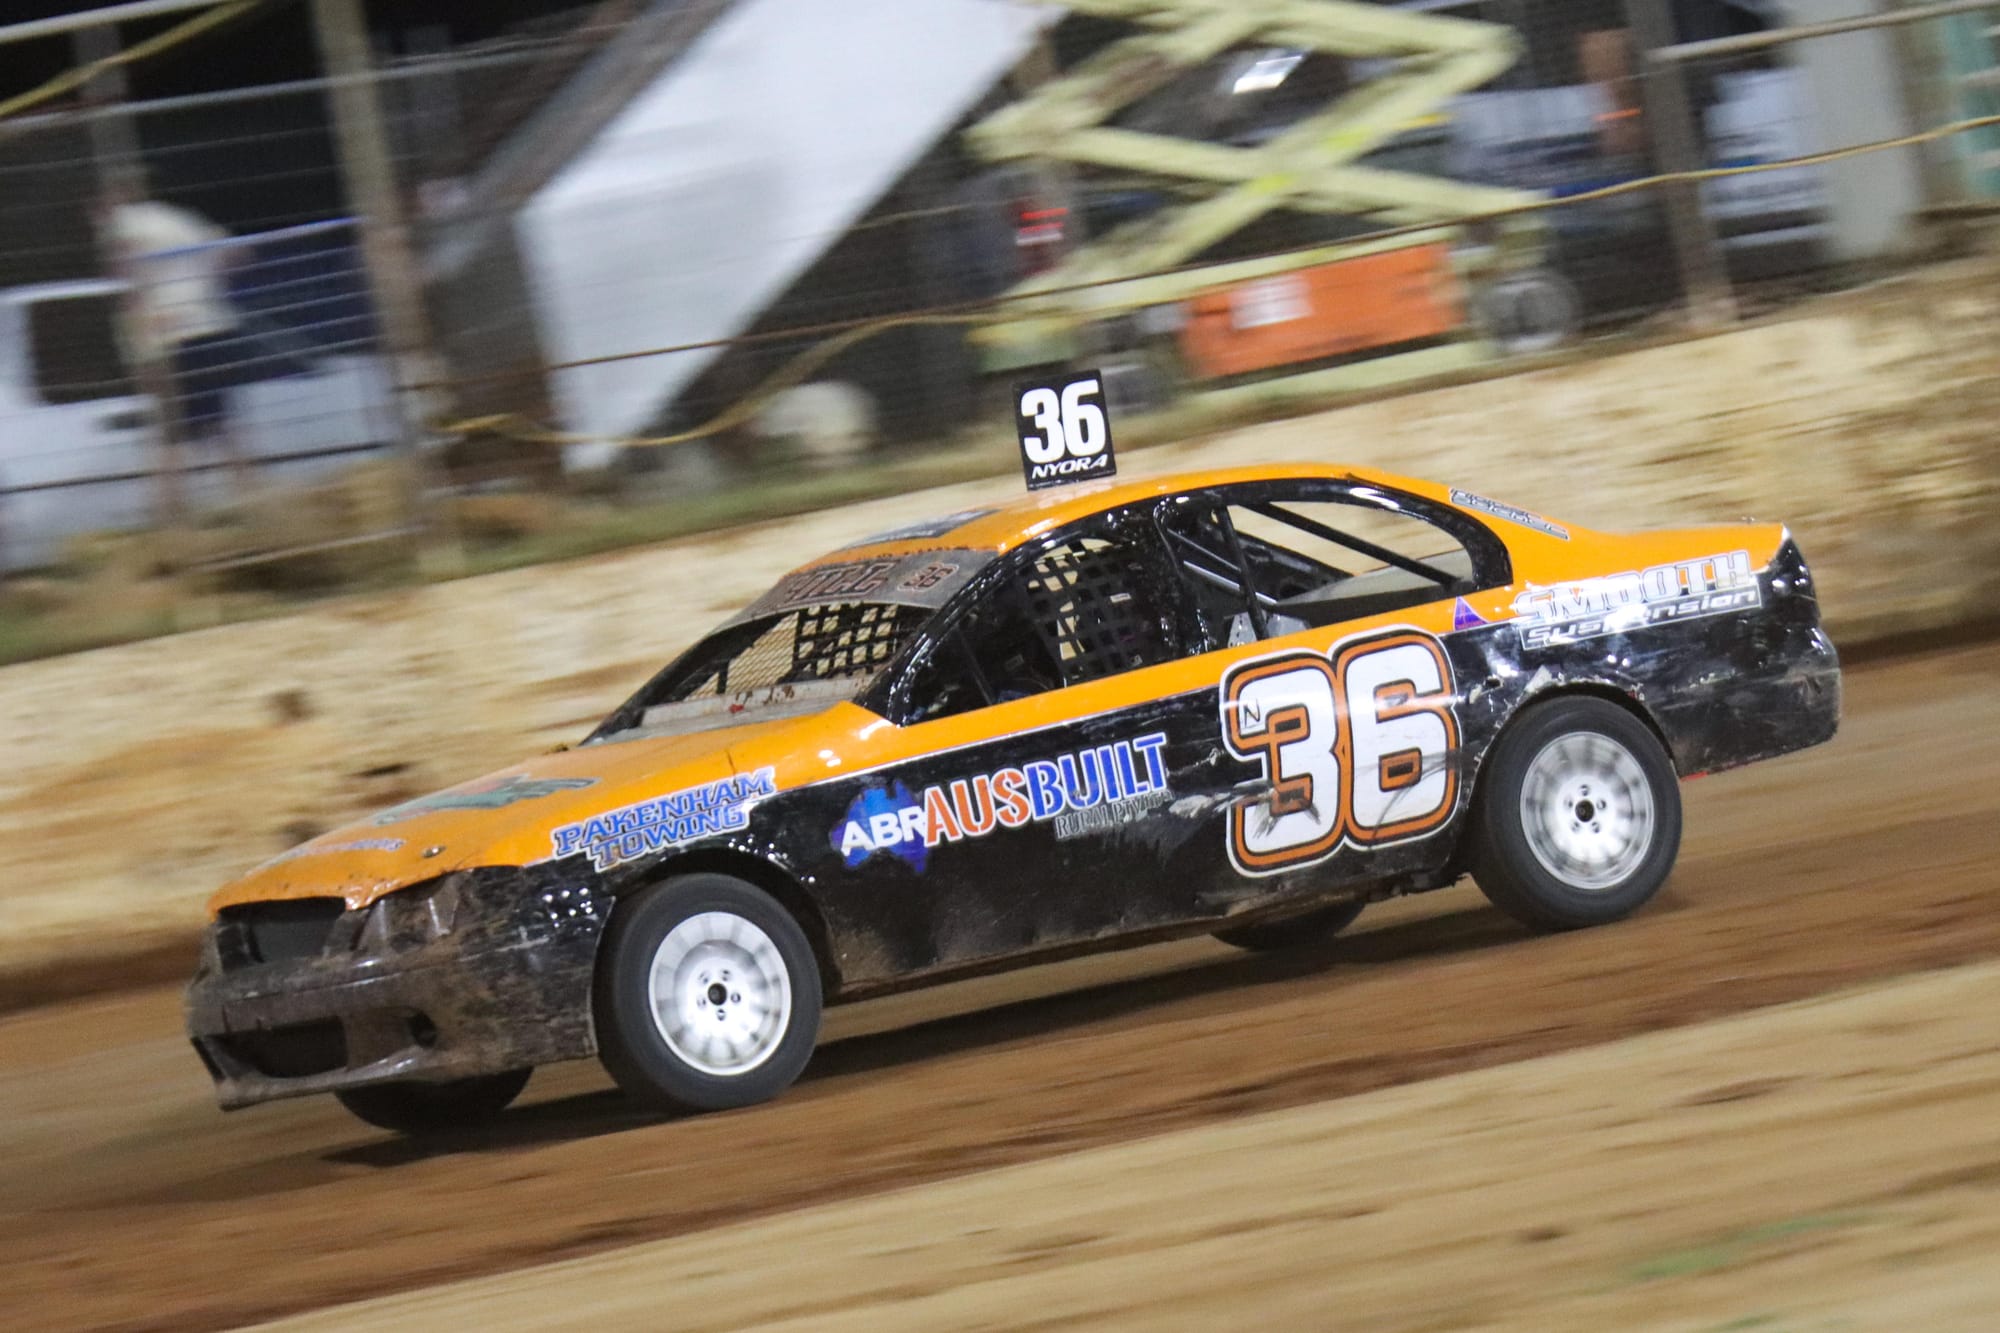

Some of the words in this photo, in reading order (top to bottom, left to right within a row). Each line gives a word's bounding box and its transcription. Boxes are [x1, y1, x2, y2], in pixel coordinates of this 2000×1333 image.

[1021, 378, 1106, 464] 36
[1032, 454, 1108, 480] NYORA
[1513, 550, 1750, 618] SMOOTH
[1224, 629, 1459, 870] 36
[555, 767, 776, 857] PAKENHAM
[589, 803, 749, 870] TOWING
[841, 805, 926, 857] ABR
[924, 732, 1166, 848] AUSBUILT
